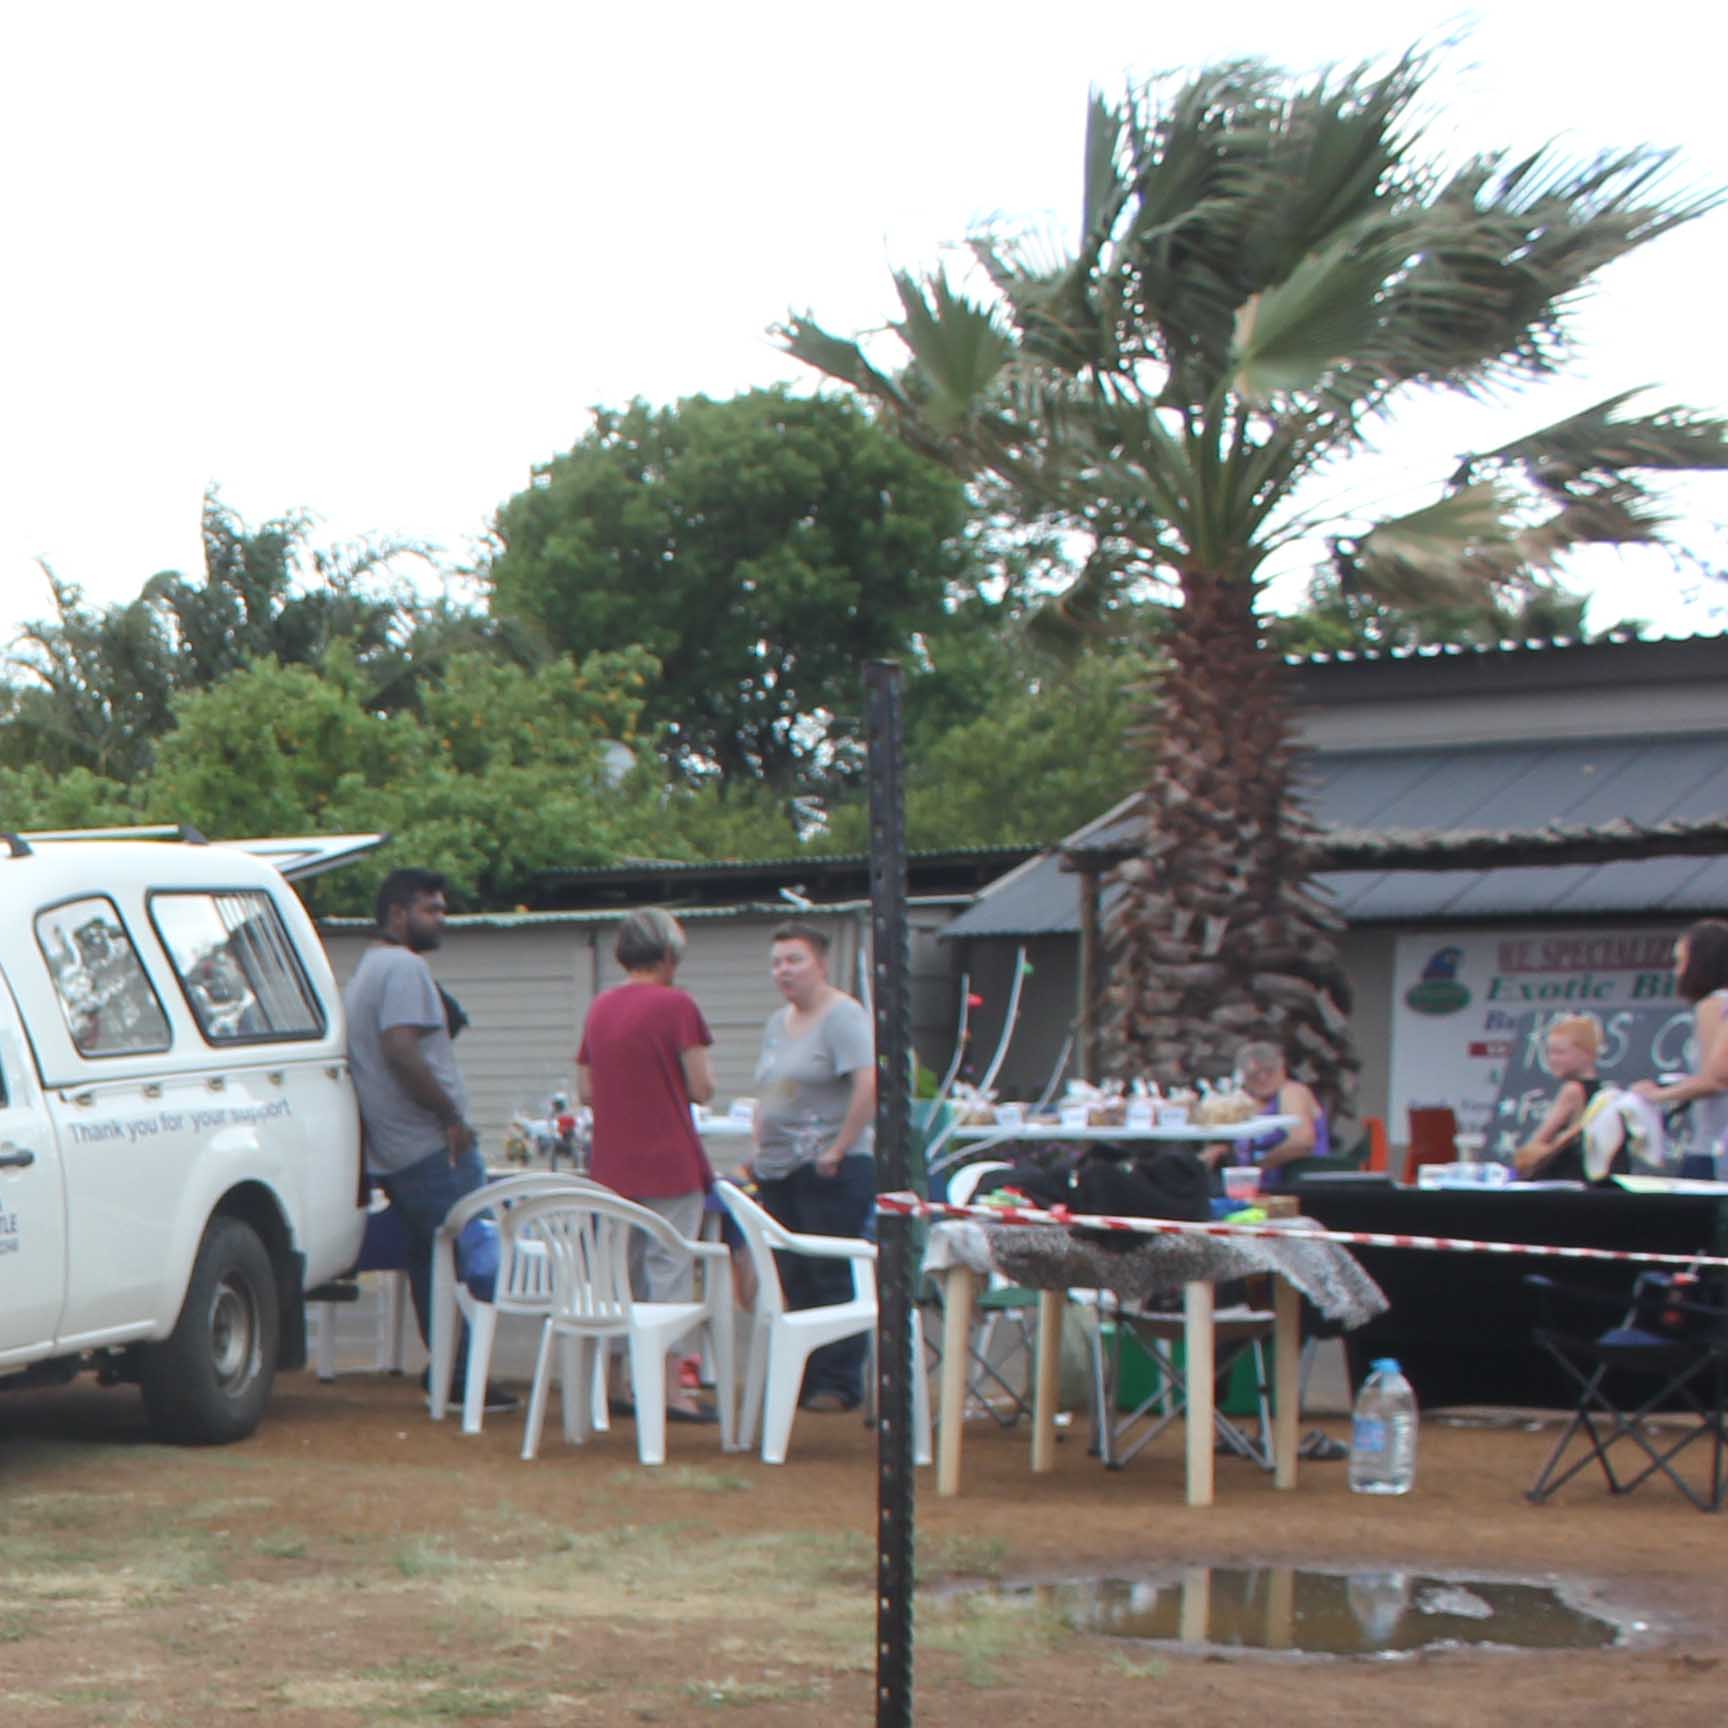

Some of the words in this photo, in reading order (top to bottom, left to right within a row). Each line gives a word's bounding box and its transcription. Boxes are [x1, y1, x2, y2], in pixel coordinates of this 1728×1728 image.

[1486, 973, 1617, 1001] Exotic
[69, 1120, 125, 1143] Thank
[127, 1119, 159, 1142] you
[159, 1111, 185, 1132] for
[190, 1109, 226, 1133] your
[230, 1099, 292, 1124] support
